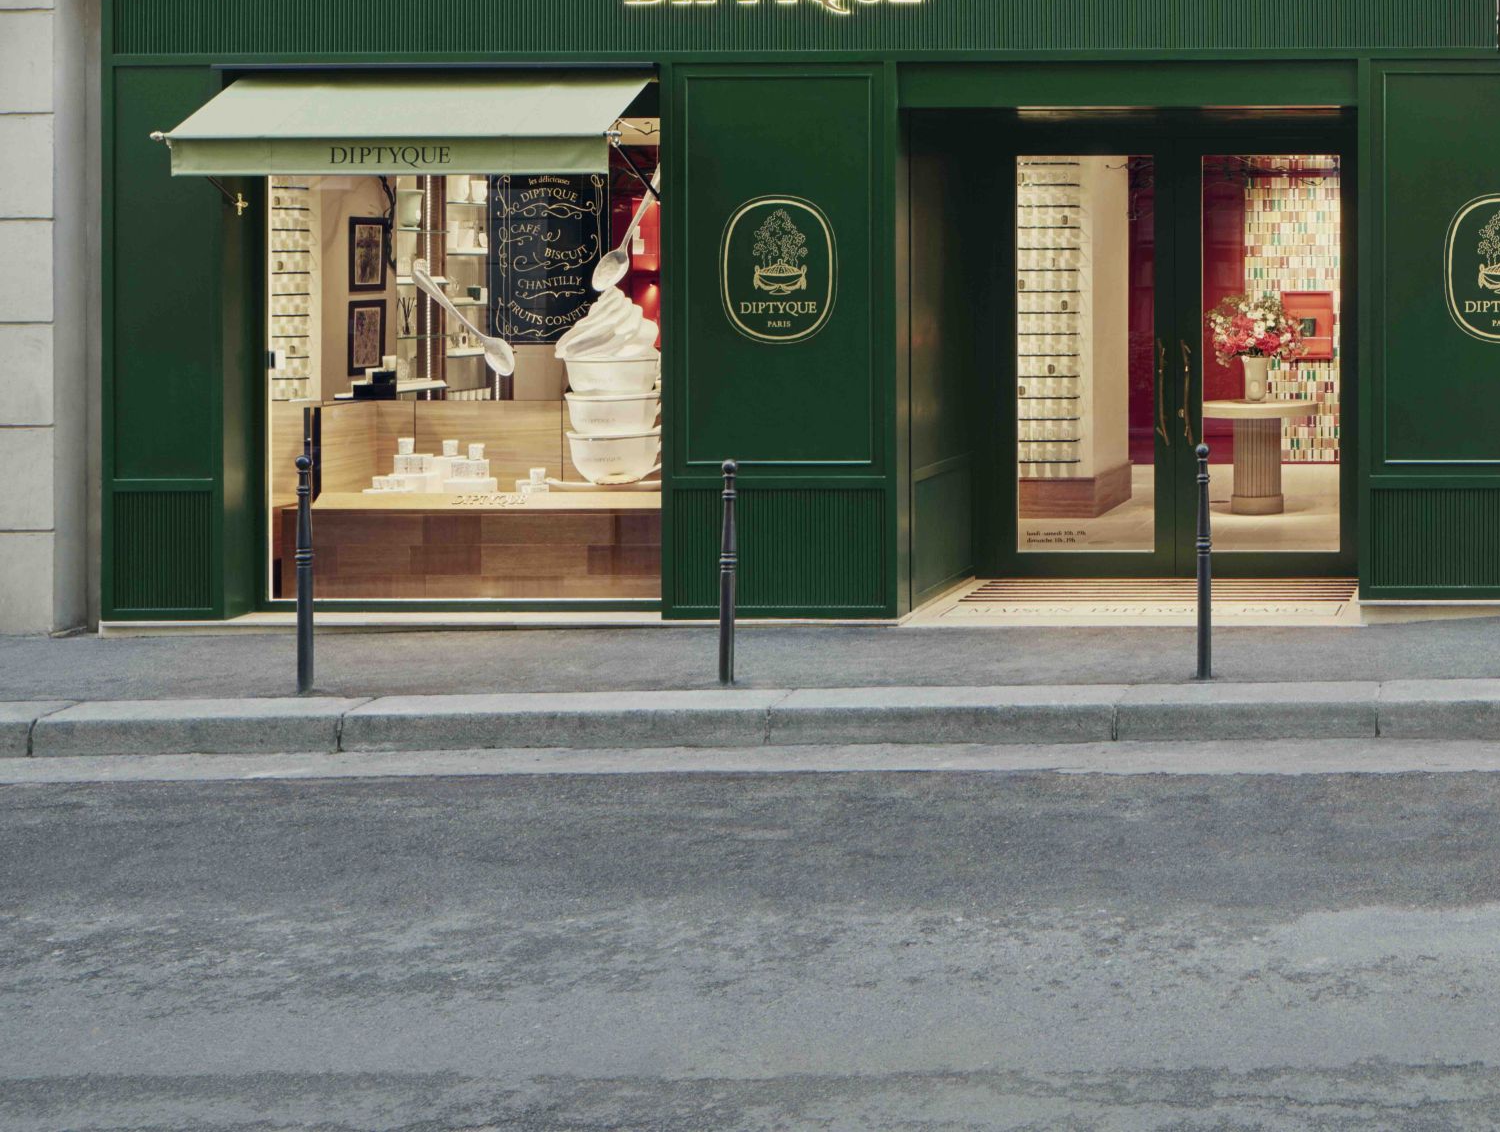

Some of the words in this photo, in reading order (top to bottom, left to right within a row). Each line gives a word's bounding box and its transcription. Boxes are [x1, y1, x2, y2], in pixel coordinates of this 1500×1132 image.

[329, 146, 451, 168] DIPTYQUE
[520, 187, 579, 203] DIPTYQUE
[510, 223, 541, 236] CAFÉ
[544, 244, 588, 260] BISCUIT
[517, 275, 583, 290] CHANTILLY
[507, 300, 543, 325] FRUITS
[545, 300, 593, 326] CONFITS
[740, 301, 817, 316] DIPTYQUE
[767, 320, 791, 328] PARIS
